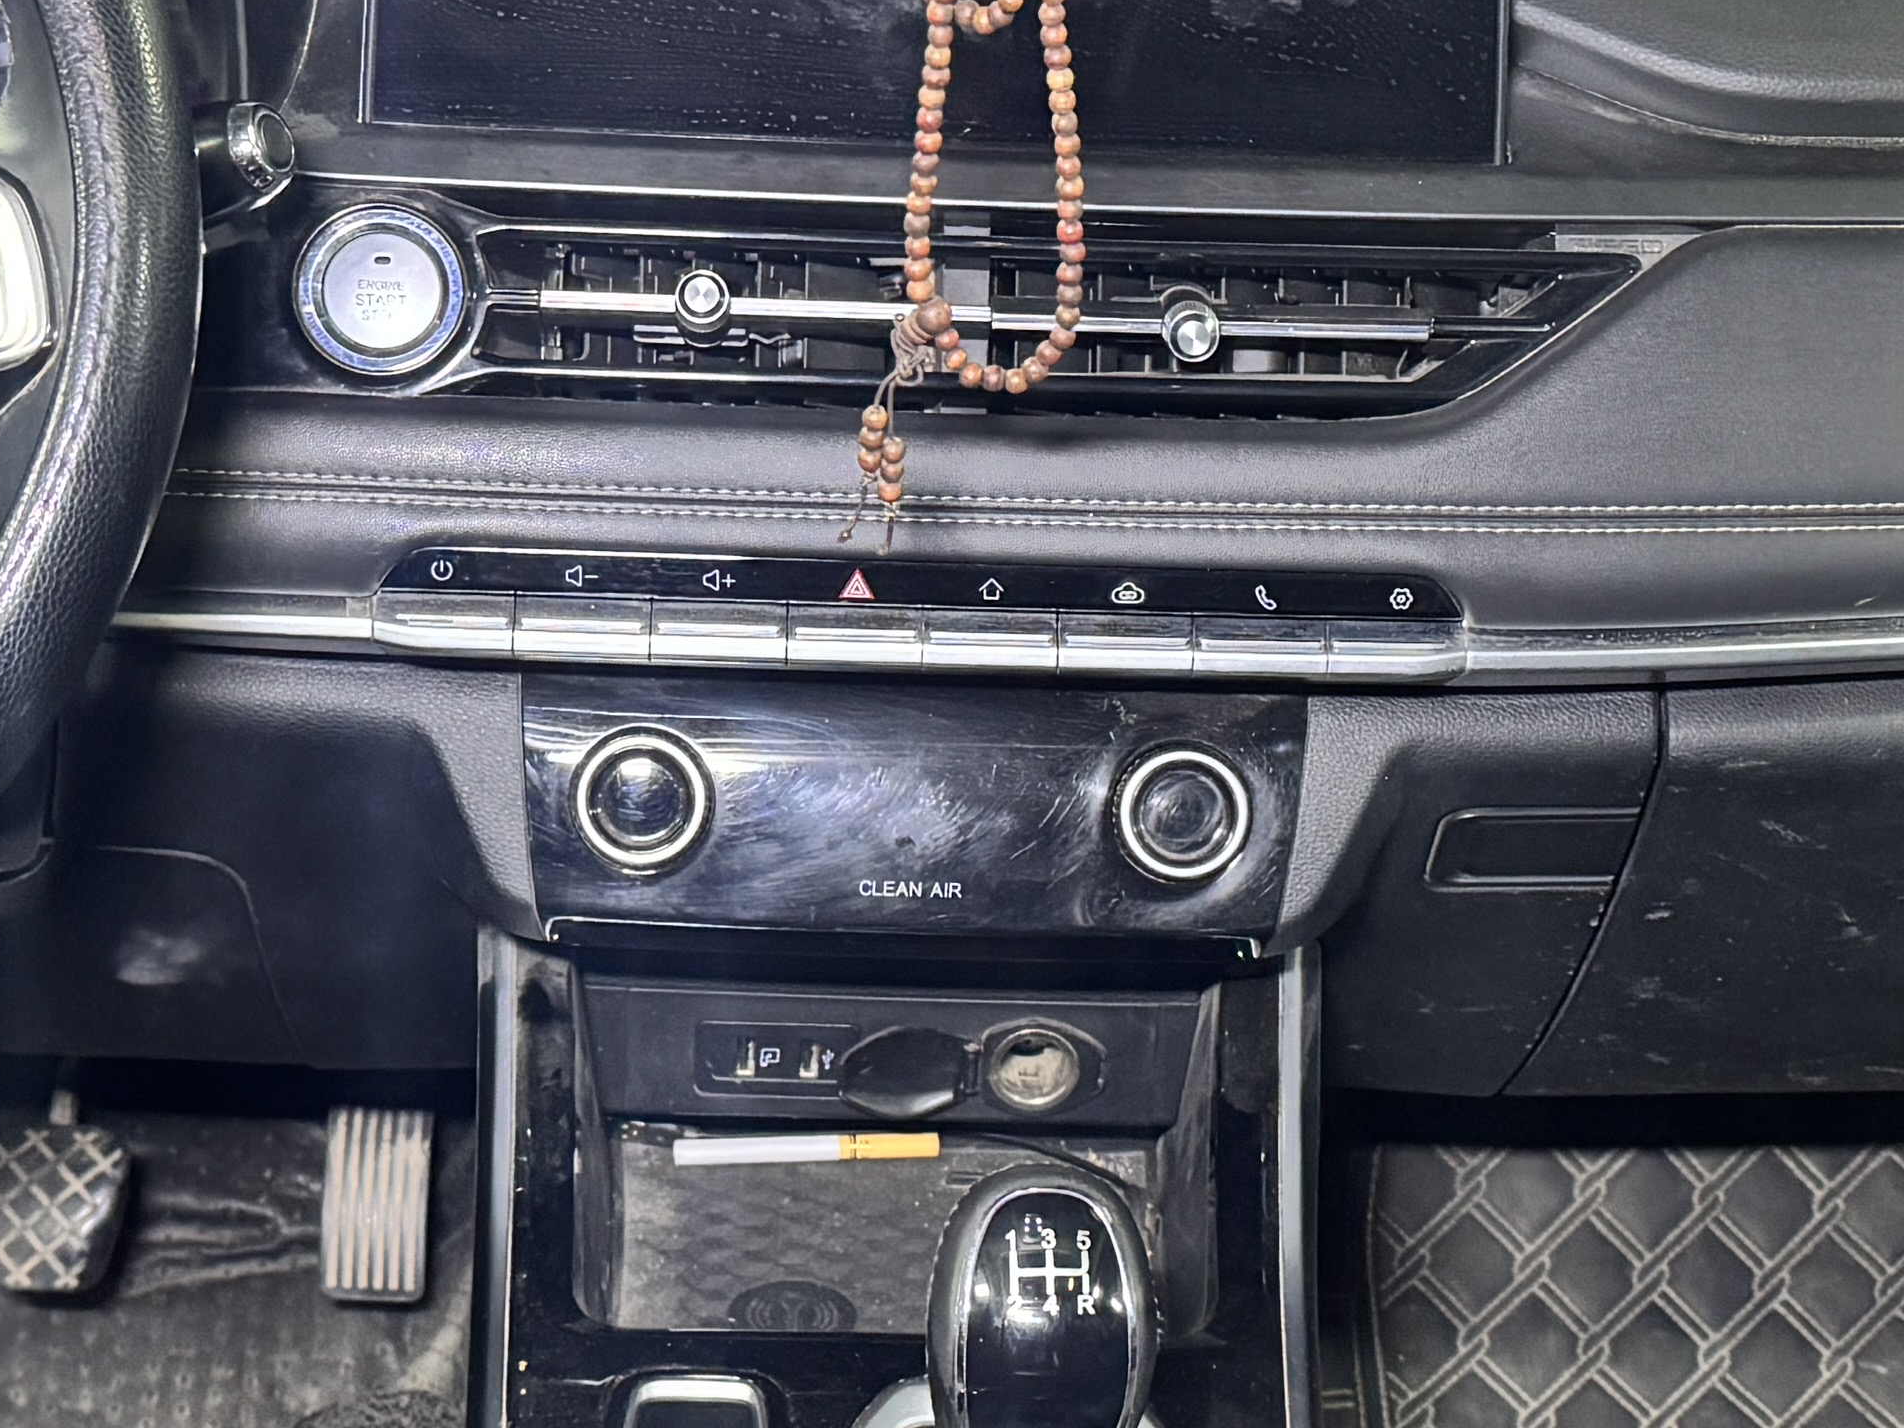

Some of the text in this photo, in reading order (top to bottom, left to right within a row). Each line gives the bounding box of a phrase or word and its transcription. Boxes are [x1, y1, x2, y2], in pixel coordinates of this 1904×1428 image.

[355, 293, 407, 307] START
[859, 880, 963, 899] CLEAN AIR
[1005, 1228, 1091, 1250] 1 3 5
[1006, 1295, 1096, 1316] 2 4 R
